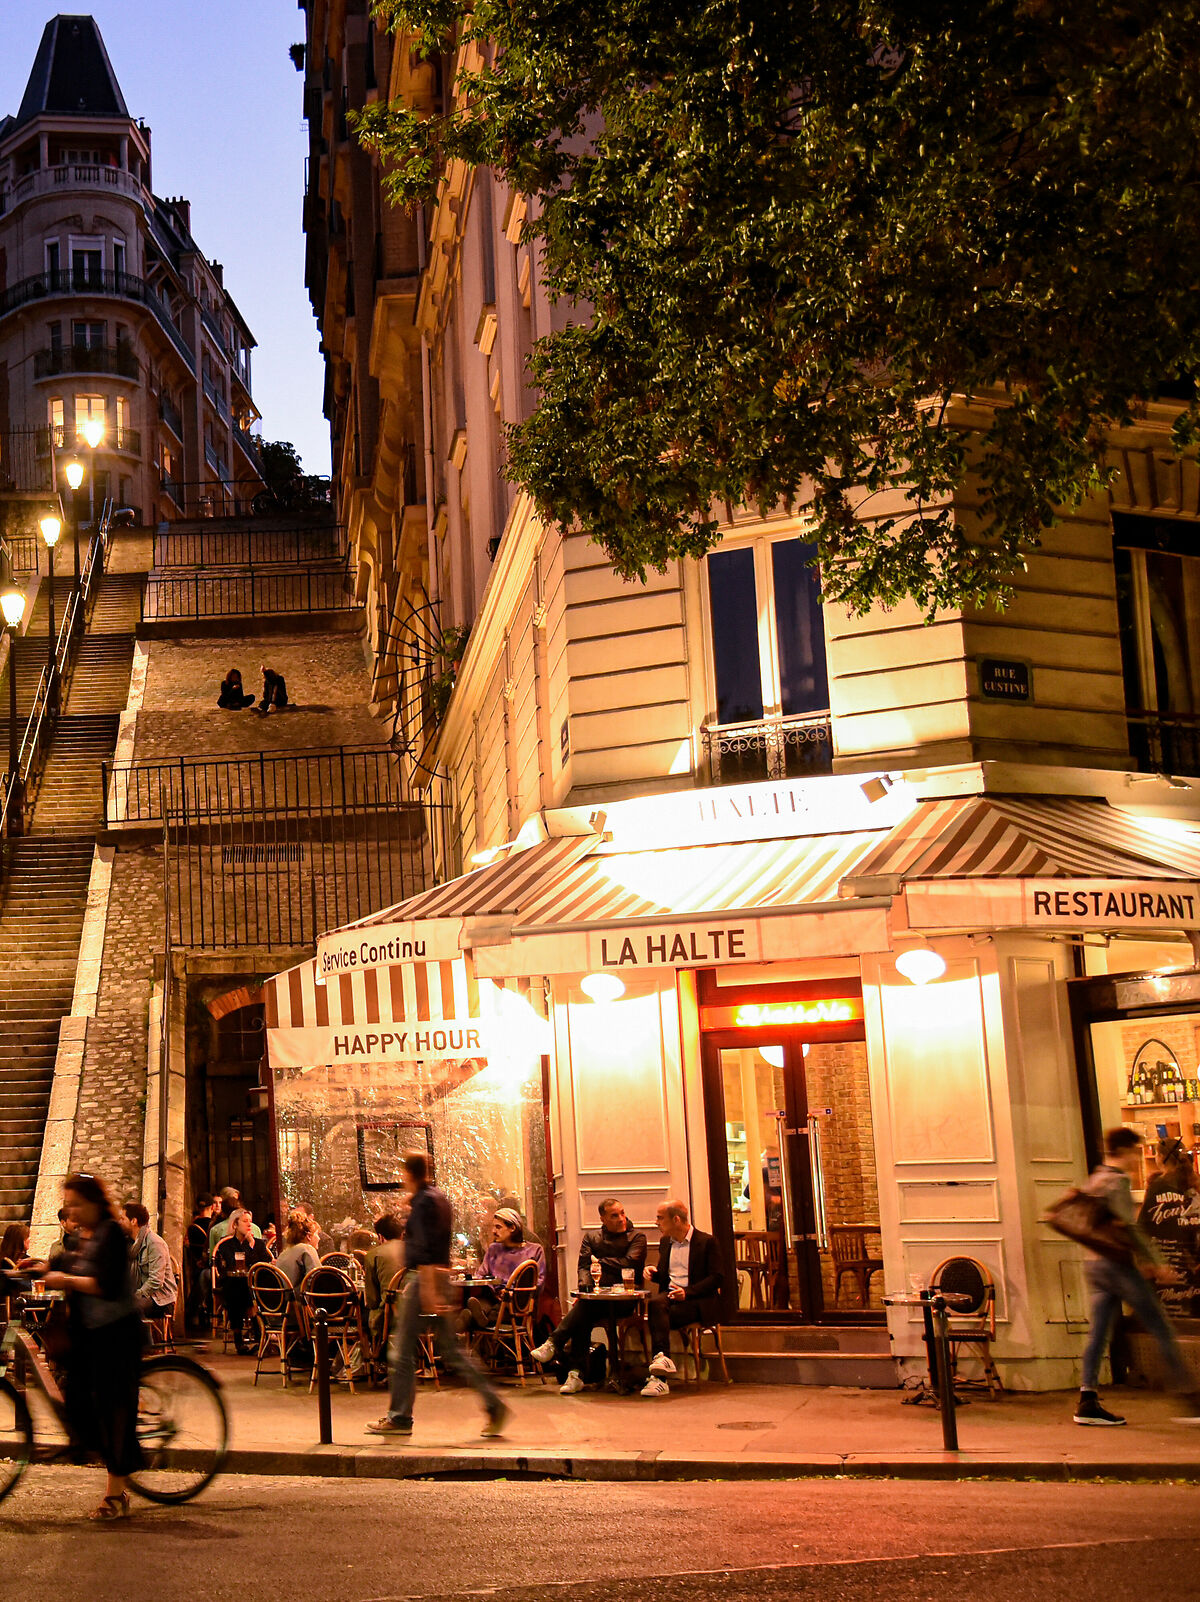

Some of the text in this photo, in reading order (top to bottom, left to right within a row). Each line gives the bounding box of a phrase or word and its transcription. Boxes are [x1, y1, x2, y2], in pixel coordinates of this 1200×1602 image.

[984, 681, 1028, 694] CUSTINE
[994, 667, 1016, 679] RUE
[1033, 890, 1195, 920] RESTAURANT
[322, 936, 426, 972] Service Continu
[601, 929, 746, 966] LA HALTE
[334, 1028, 481, 1056] HAPPY HOUR
